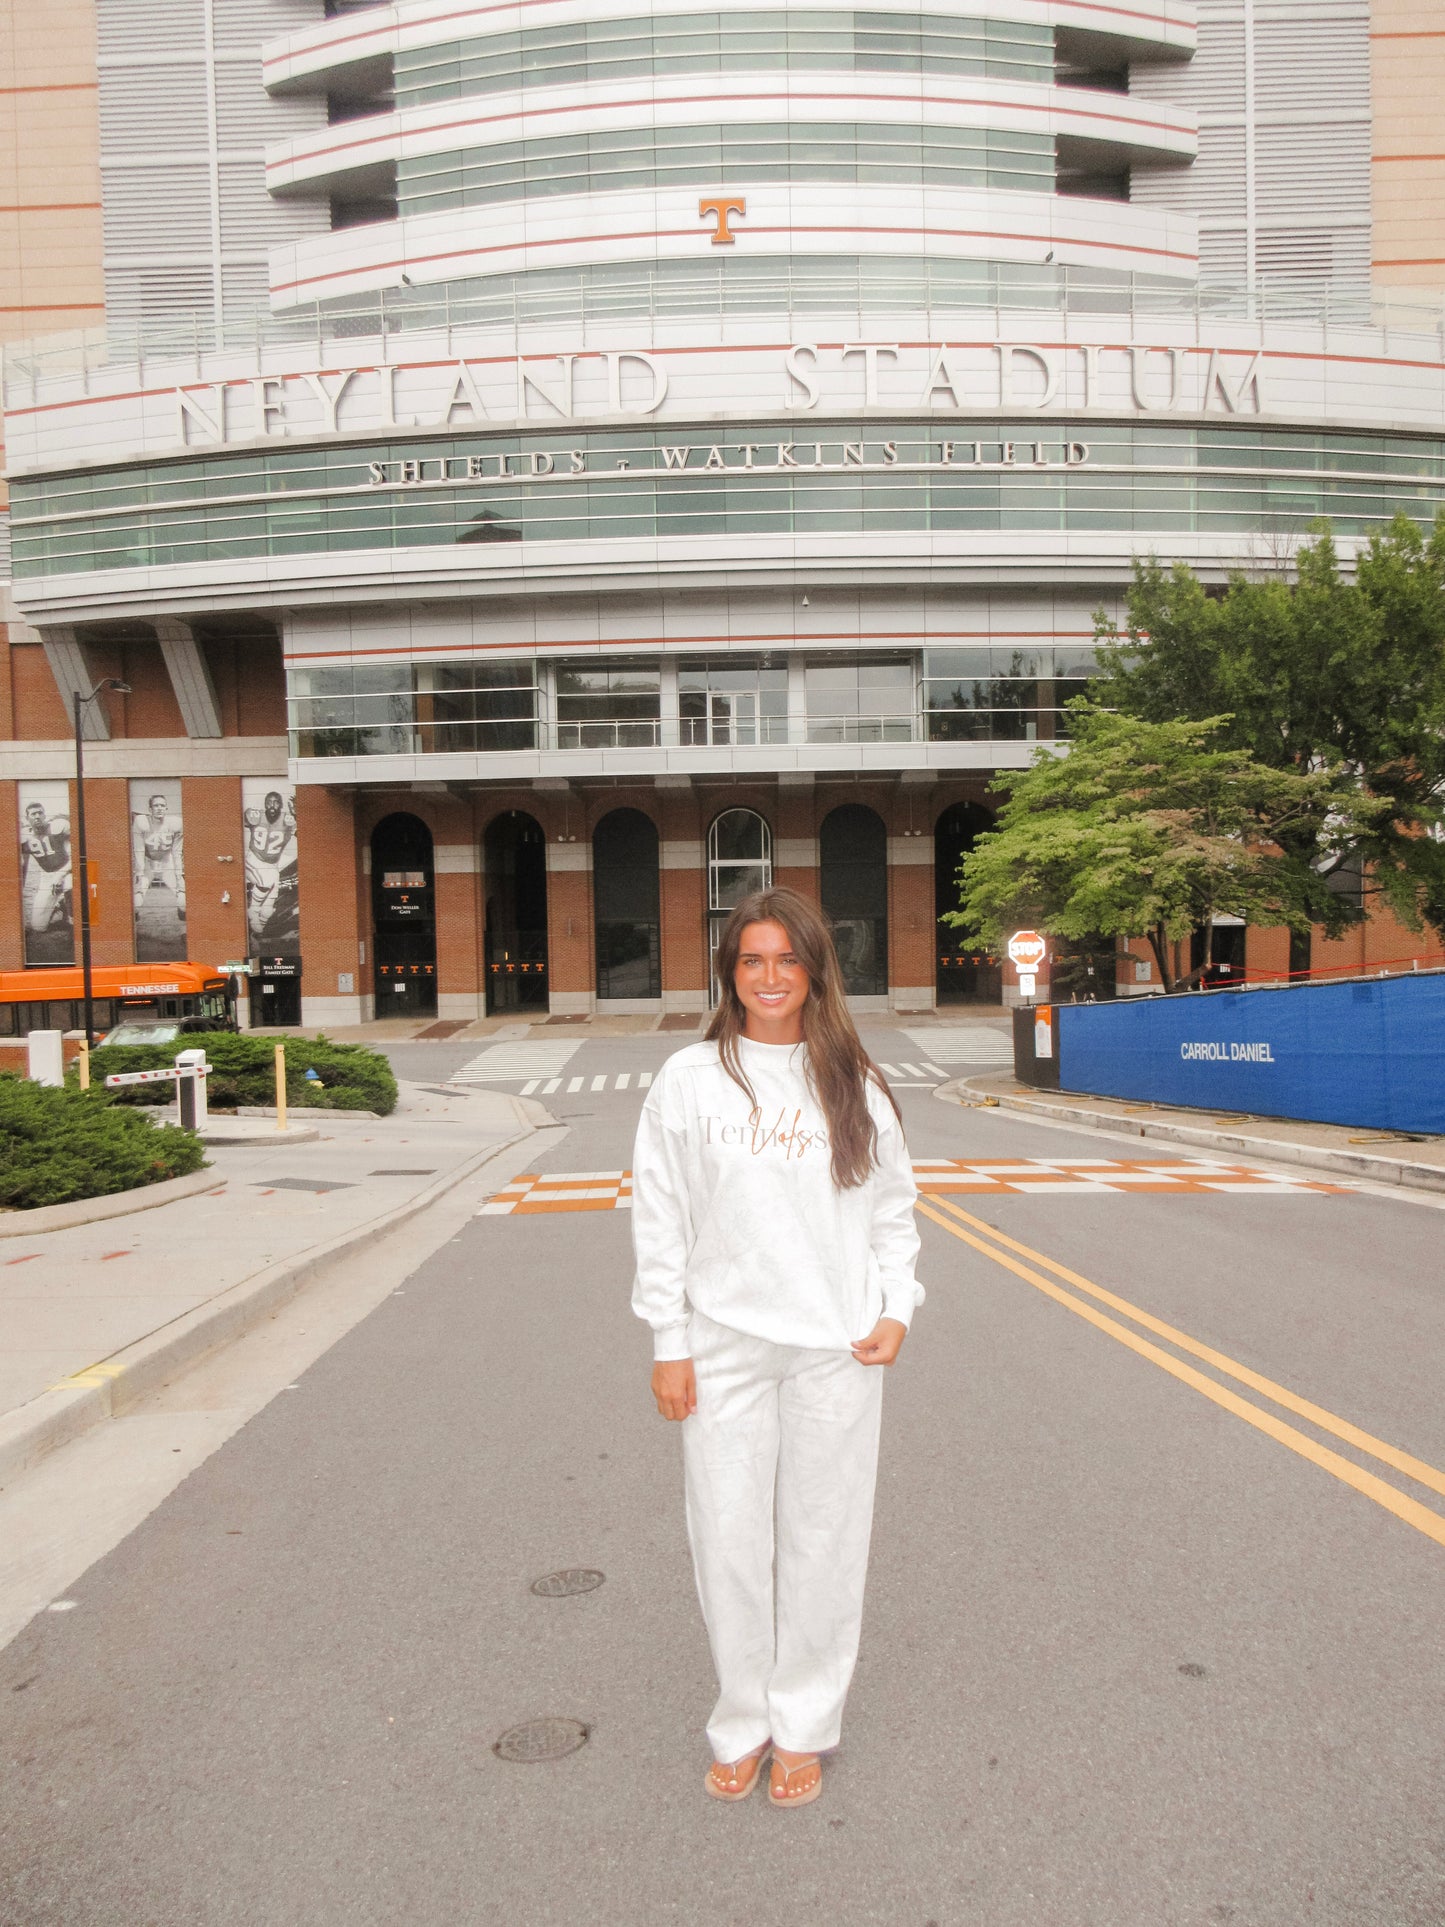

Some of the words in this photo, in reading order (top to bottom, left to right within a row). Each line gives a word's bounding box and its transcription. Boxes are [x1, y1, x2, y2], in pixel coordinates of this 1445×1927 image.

[699, 197, 746, 244] T
[176, 350, 669, 446] NEYLAND
[784, 343, 1264, 414] STADIUM
[369, 449, 585, 485] SHIELDS
[660, 441, 898, 469] WATKINS
[940, 441, 1090, 465] FIELD
[28, 836, 56, 858] 91
[252, 826, 285, 855] 92
[1010, 941, 1043, 957] STOP
[119, 983, 180, 996] TENNESSEE
[1181, 1042, 1230, 1061] CARROLL
[1230, 1042, 1275, 1062] DANIEL
[697, 1115, 829, 1150] Tenness
[748, 1105, 814, 1161] Vols
